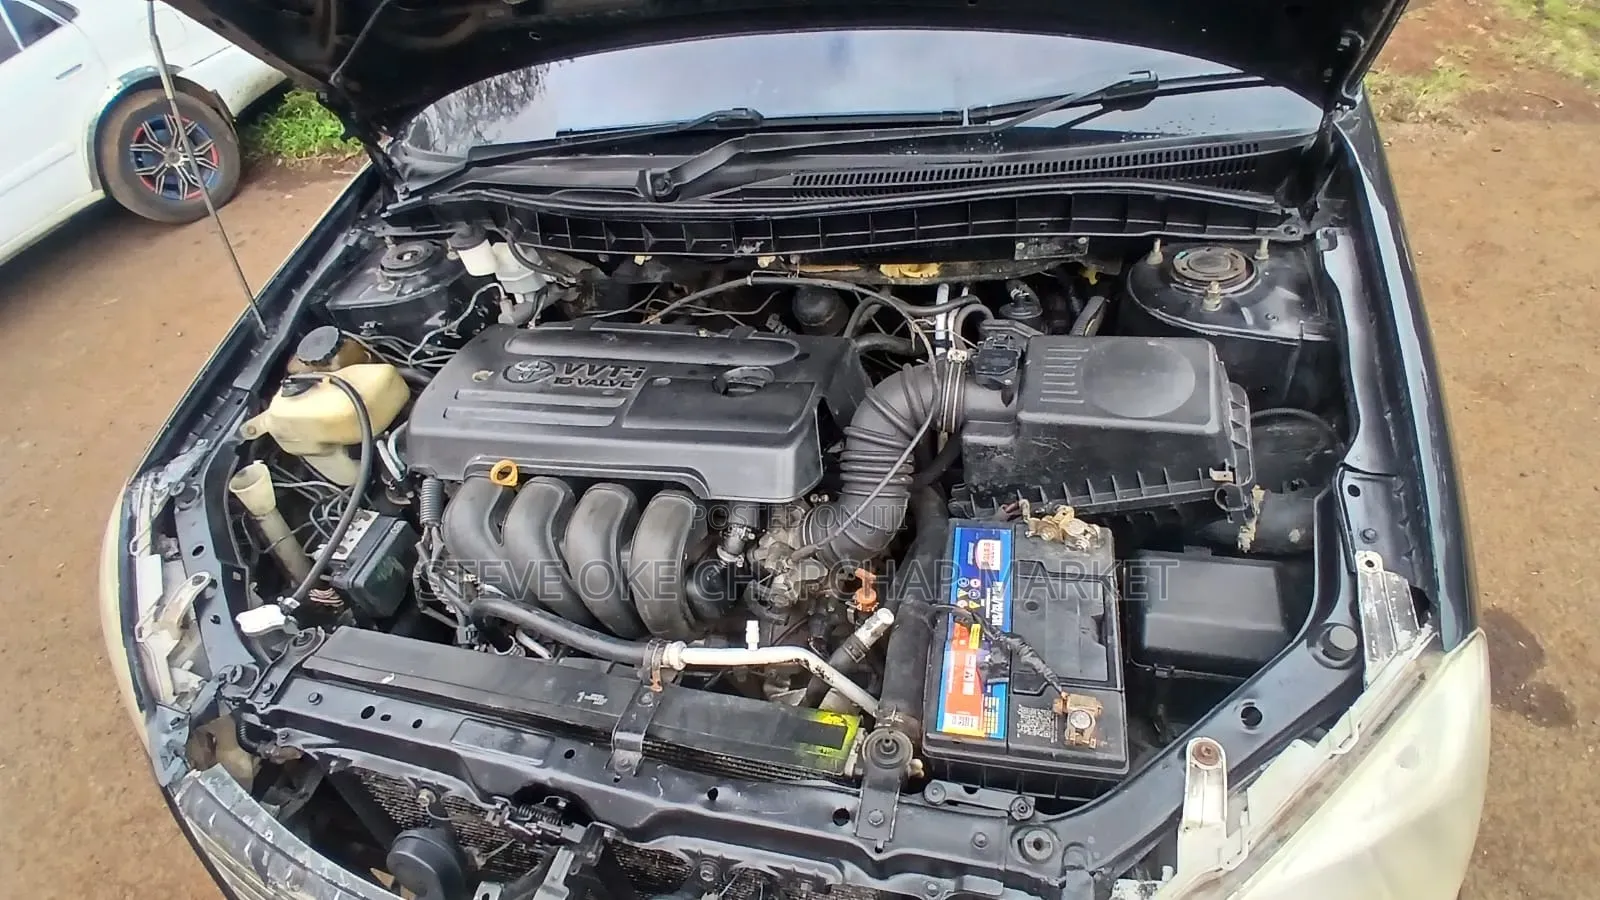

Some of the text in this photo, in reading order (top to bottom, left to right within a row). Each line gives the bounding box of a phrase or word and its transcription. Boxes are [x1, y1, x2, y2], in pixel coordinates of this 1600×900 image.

[563, 363, 647, 379] VVT-i
[553, 377, 637, 389] 16 VALVE
